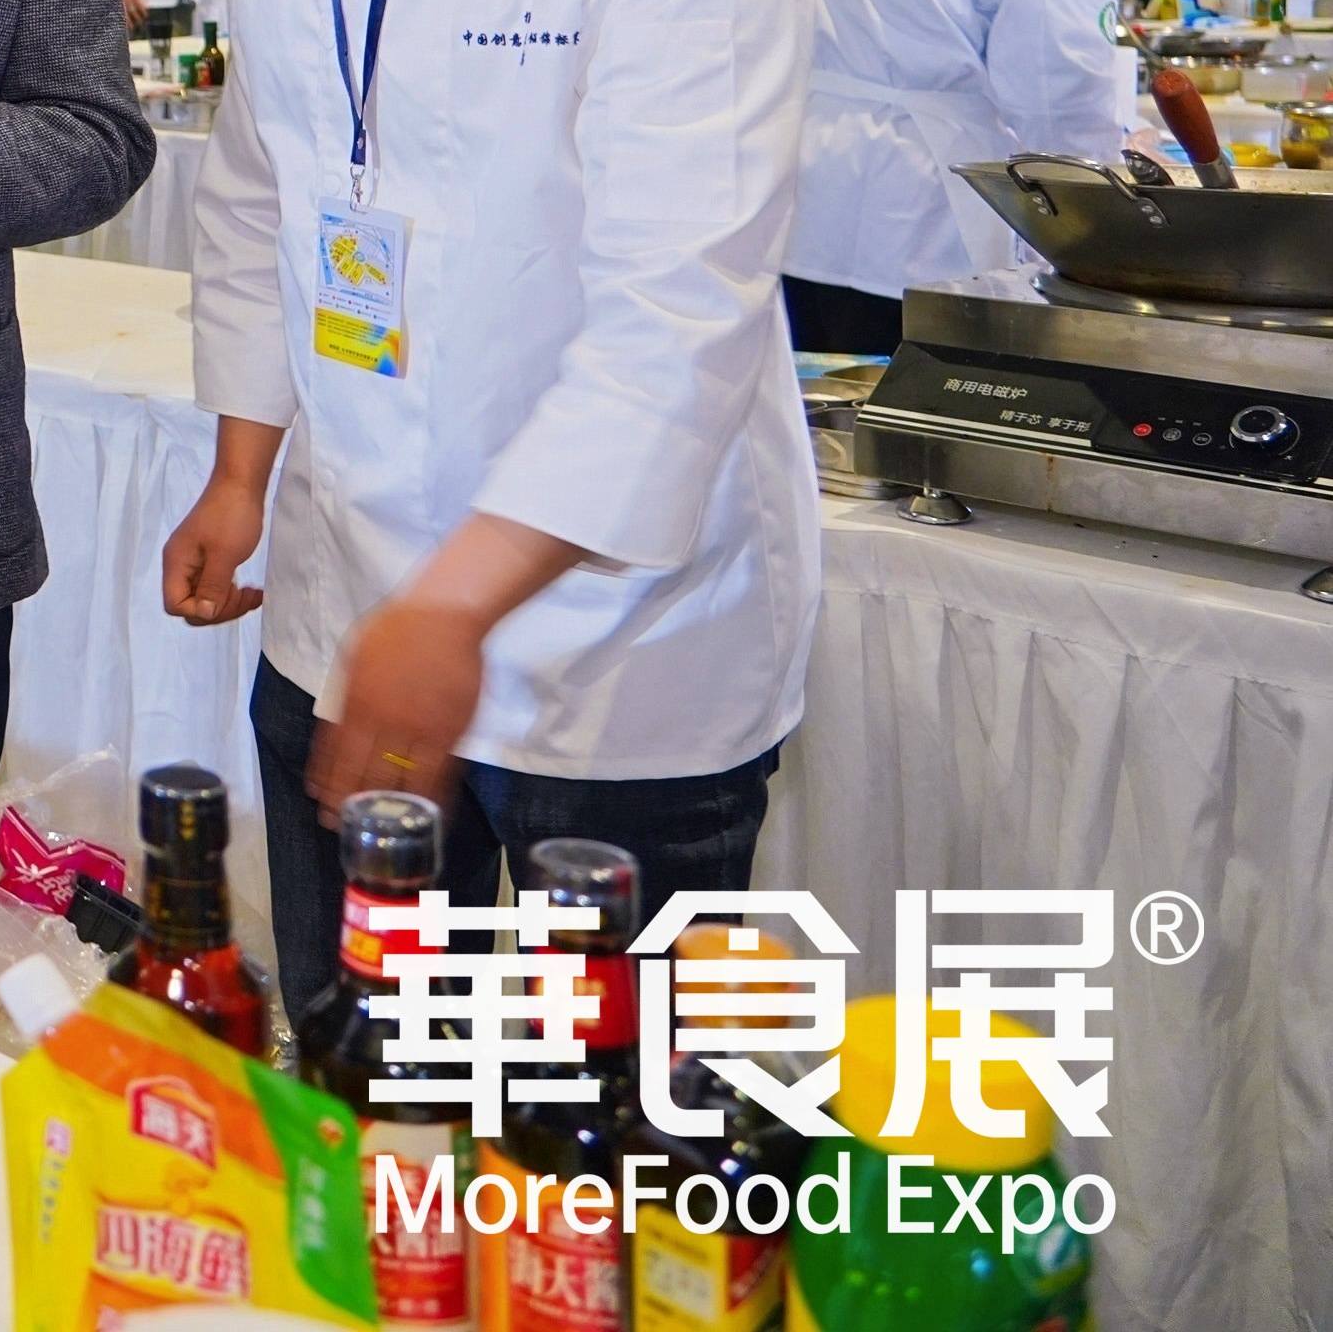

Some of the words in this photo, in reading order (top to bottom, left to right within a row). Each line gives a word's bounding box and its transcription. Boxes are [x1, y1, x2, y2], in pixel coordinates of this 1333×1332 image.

[943, 377, 1028, 400] 商用电磁炉
